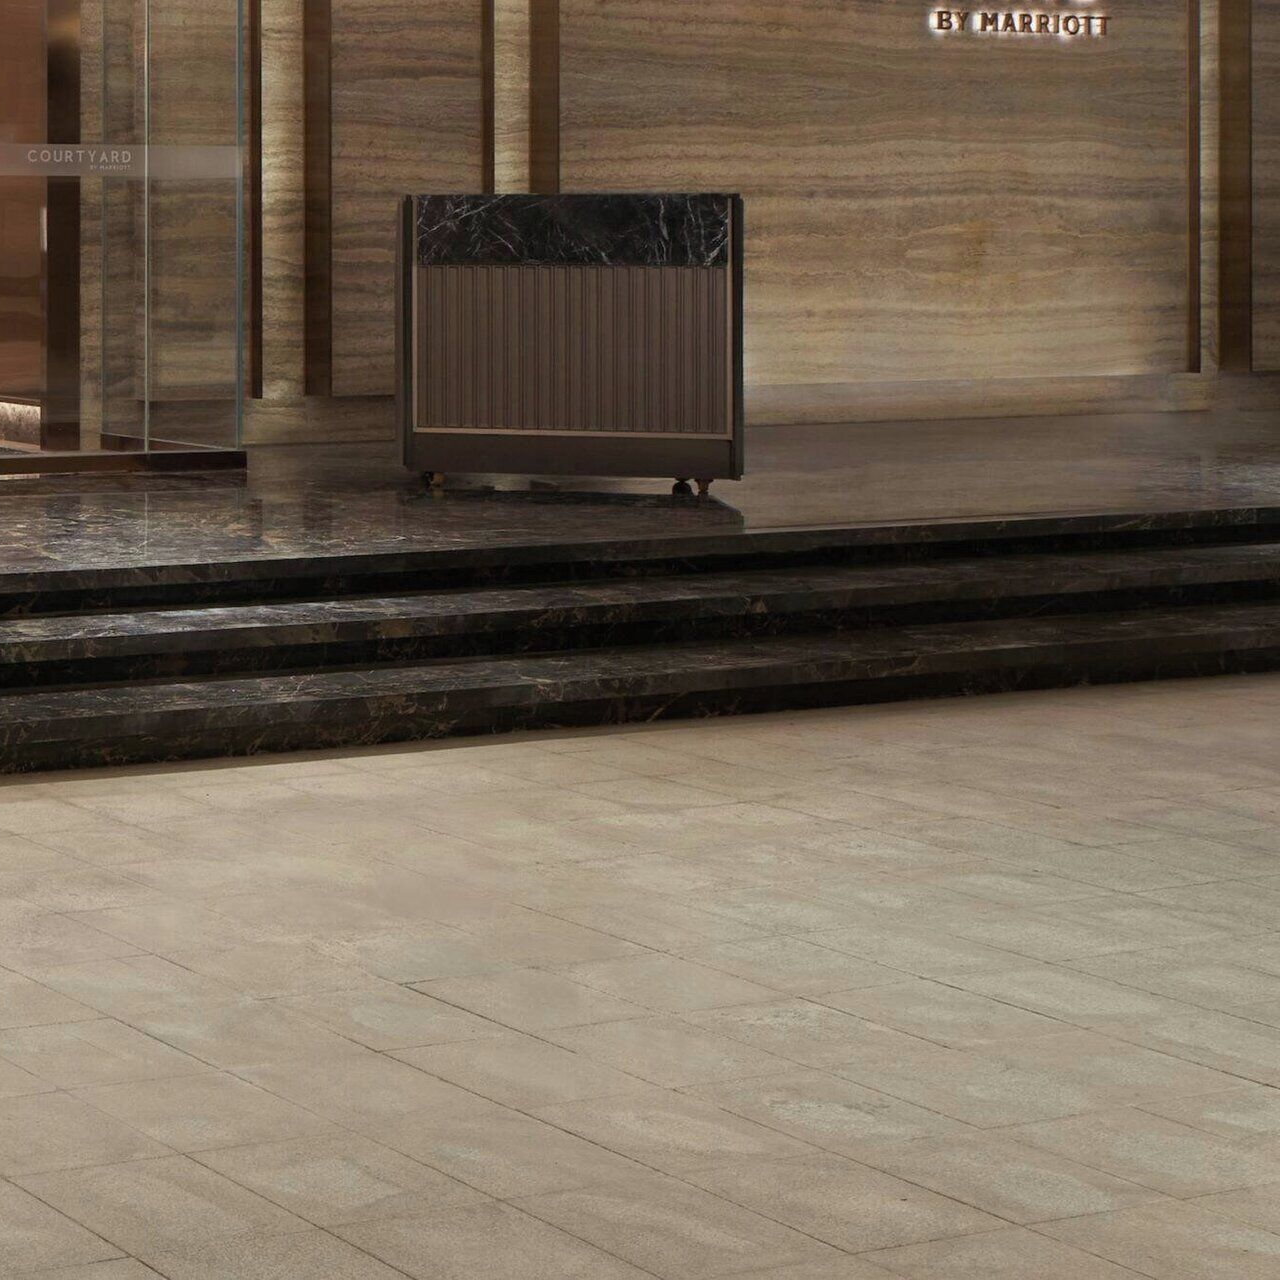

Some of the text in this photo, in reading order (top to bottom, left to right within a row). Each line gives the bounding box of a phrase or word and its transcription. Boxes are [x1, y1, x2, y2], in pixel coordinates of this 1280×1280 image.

[935, 9, 1112, 36] BY MARRIOTT
[27, 149, 132, 163] COURTYARD
